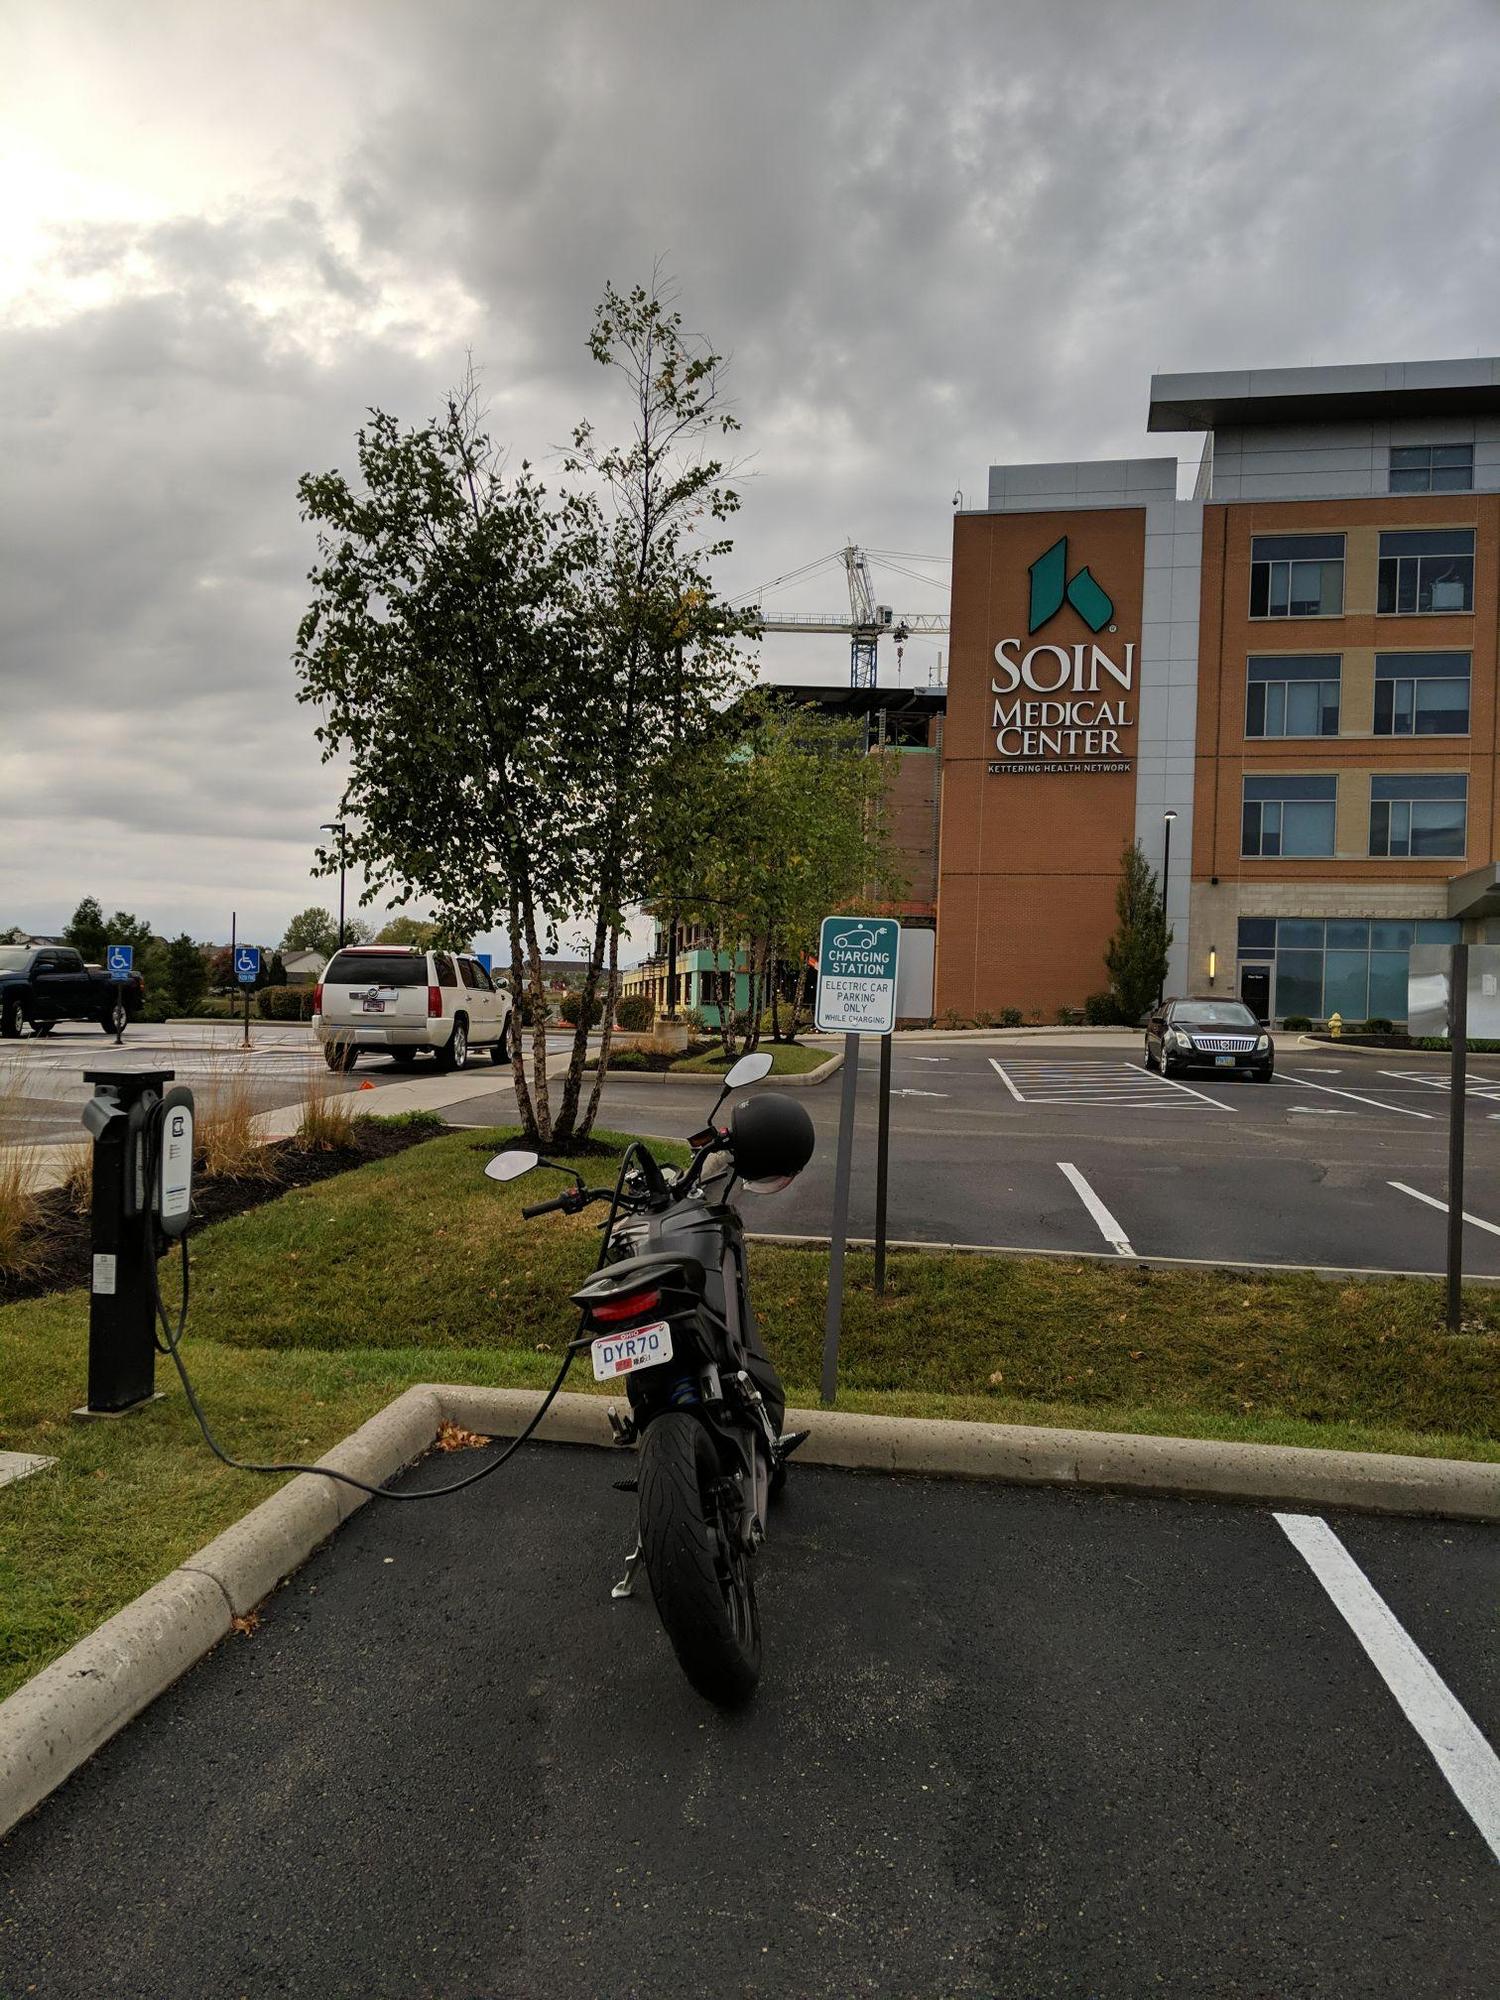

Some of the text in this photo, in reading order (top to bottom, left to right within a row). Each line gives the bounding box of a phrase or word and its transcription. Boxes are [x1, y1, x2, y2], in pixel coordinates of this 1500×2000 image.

[991, 638, 1136, 693] SOIN
[991, 698, 1133, 728] MEDICAL
[996, 726, 1124, 756] CENTER
[988, 763, 1131, 773] KETTERING HEALTH NETWORK
[828, 950, 890, 963] CHARGING
[832, 962, 884, 975] STATION
[825, 980, 889, 993] ELECTRIC CAR
[836, 992, 876, 1003] PARKING
[843, 1003, 868, 1013] ONLY
[824, 1014, 885, 1024] WHILE CHARGING
[620, 1330, 639, 1340] OHIO
